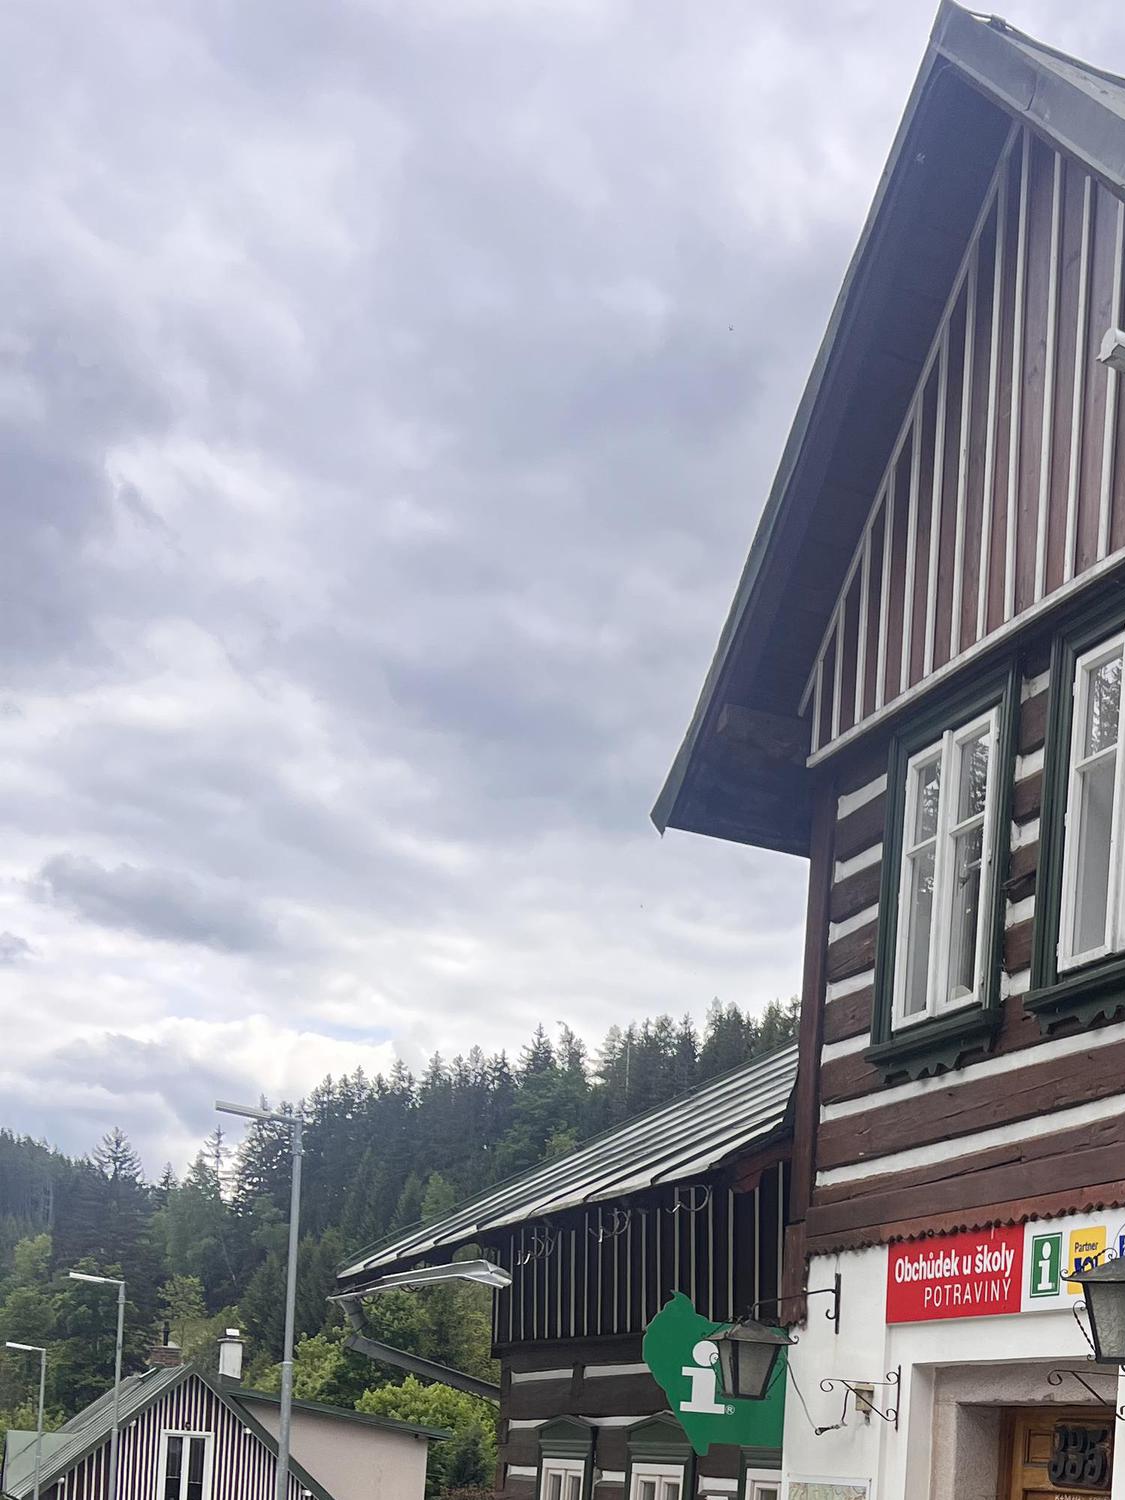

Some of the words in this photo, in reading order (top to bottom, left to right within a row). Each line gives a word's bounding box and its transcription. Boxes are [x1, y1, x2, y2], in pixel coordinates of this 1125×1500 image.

[895, 1249, 959, 1283] Obchůdek
[963, 1255, 972, 1275] u
[975, 1242, 1015, 1277] školy
[1074, 1242, 1099, 1253] Partner
[924, 1278, 1012, 1308] POTRAVINY
